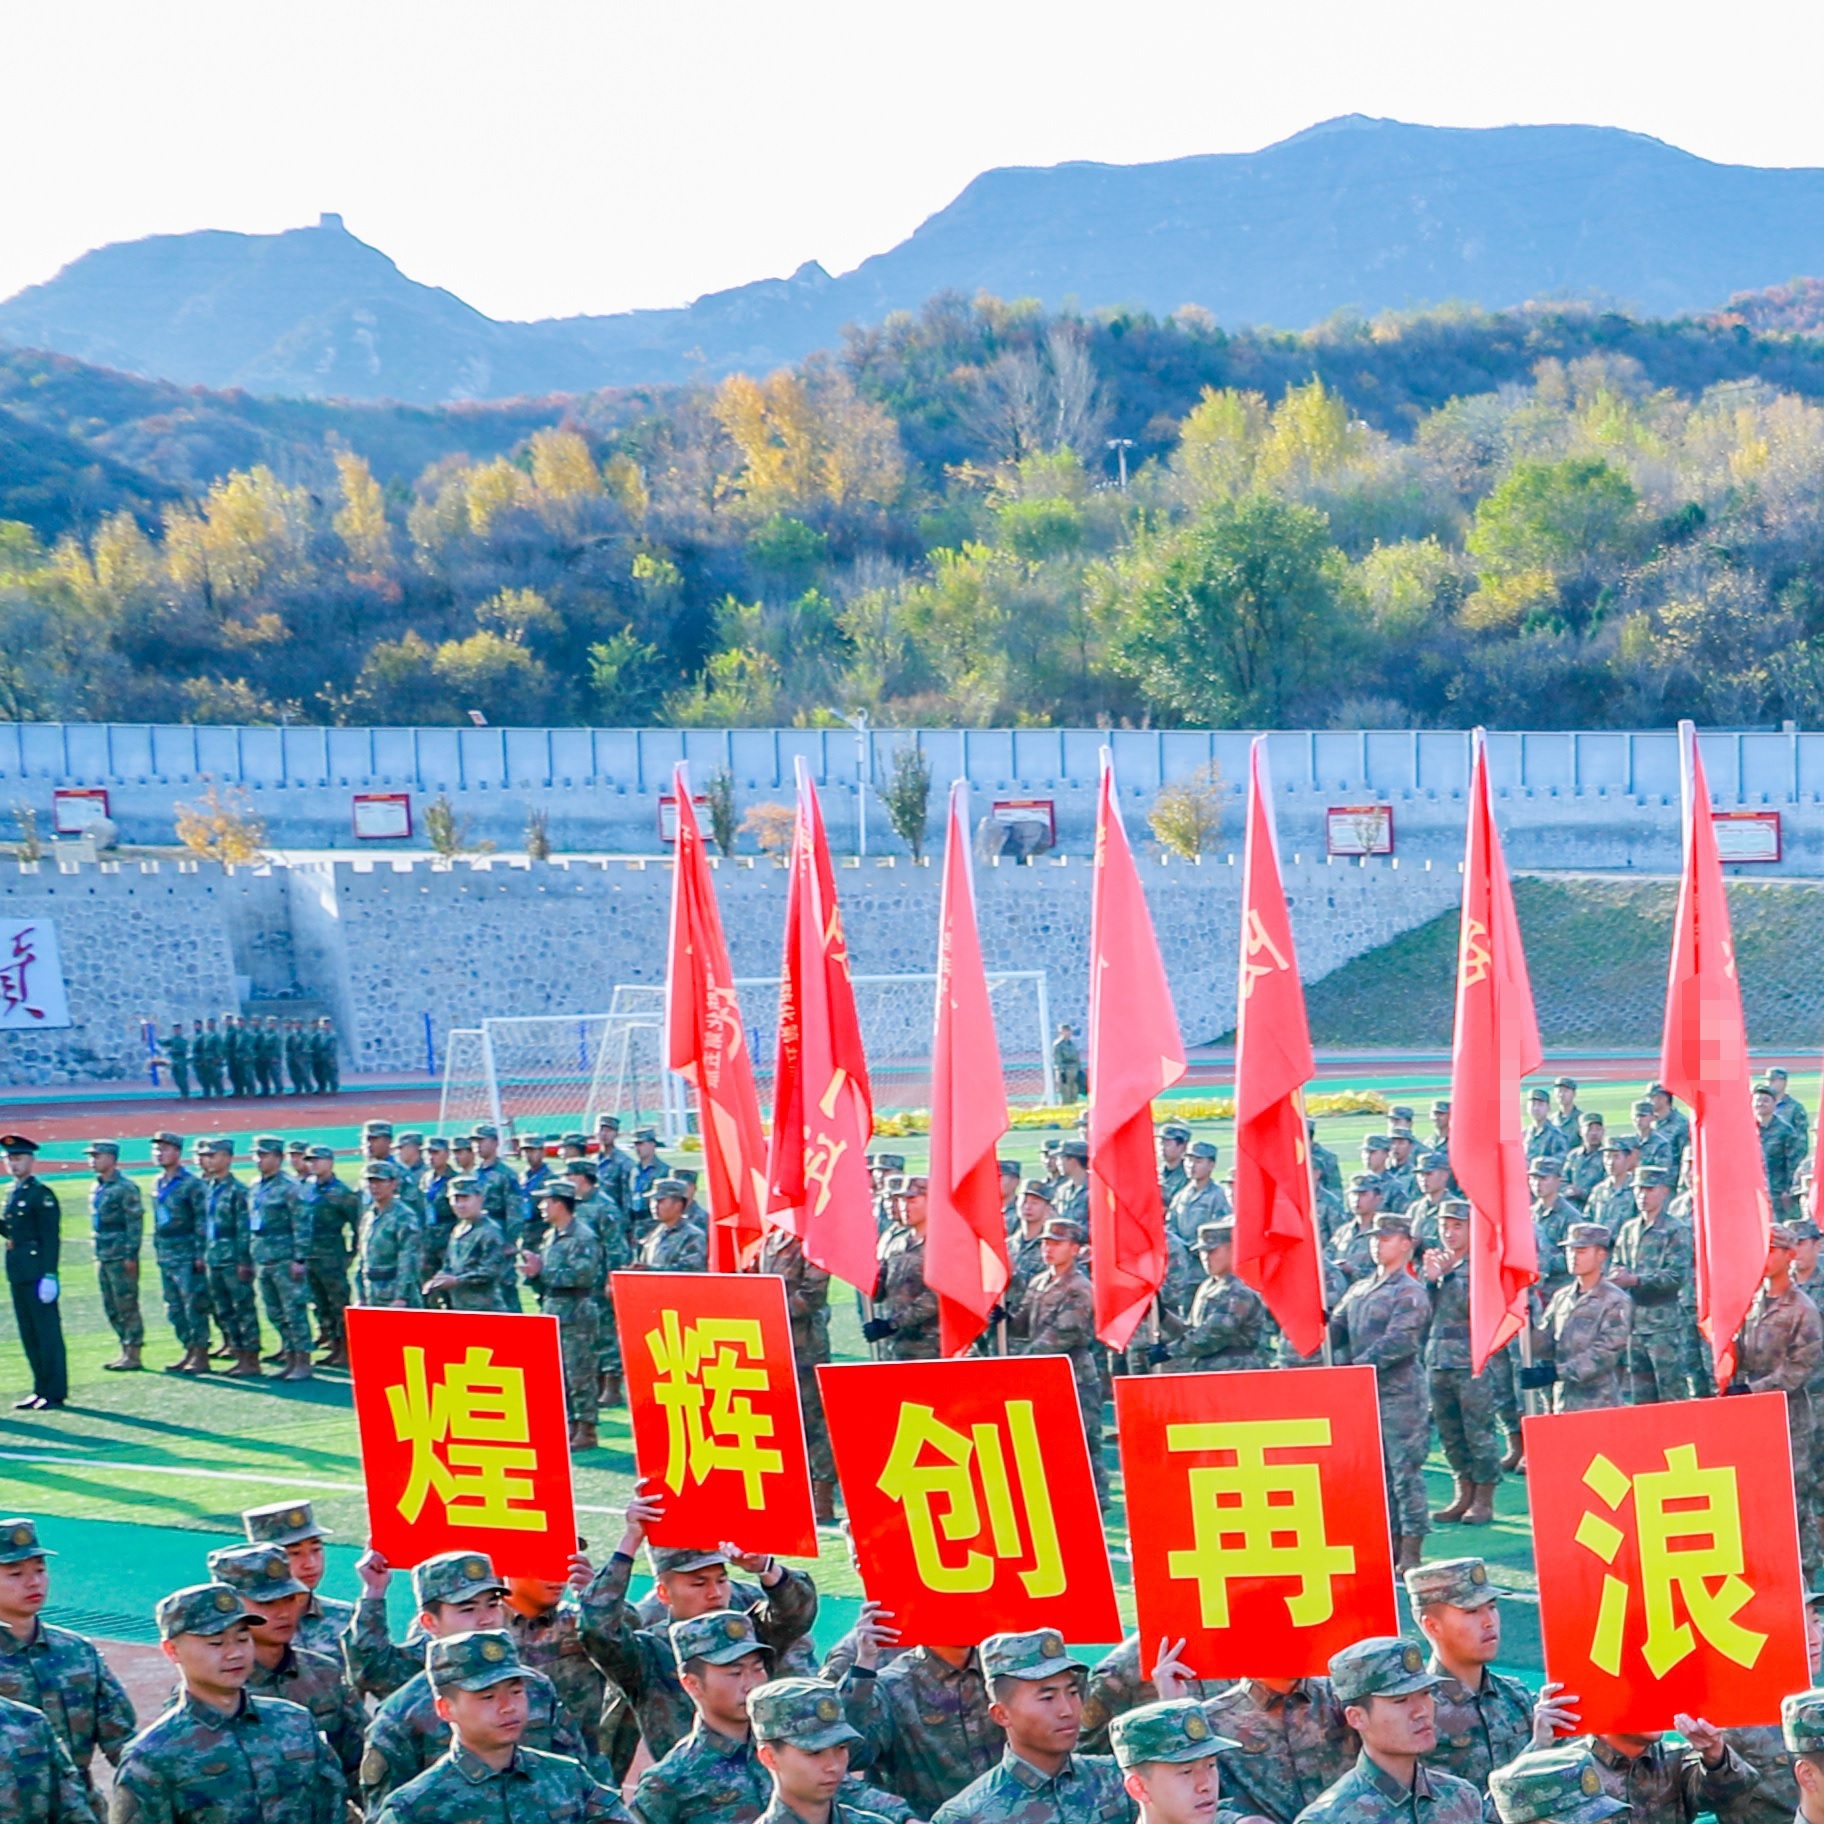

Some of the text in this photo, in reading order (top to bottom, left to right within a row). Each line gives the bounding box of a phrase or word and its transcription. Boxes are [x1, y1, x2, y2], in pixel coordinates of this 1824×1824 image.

[386, 1347, 546, 1531] 煌
[645, 1310, 783, 1509] 辉
[878, 1401, 1065, 1597] 创
[1167, 1420, 1355, 1627] 再
[1577, 1446, 1766, 1677] 浪
